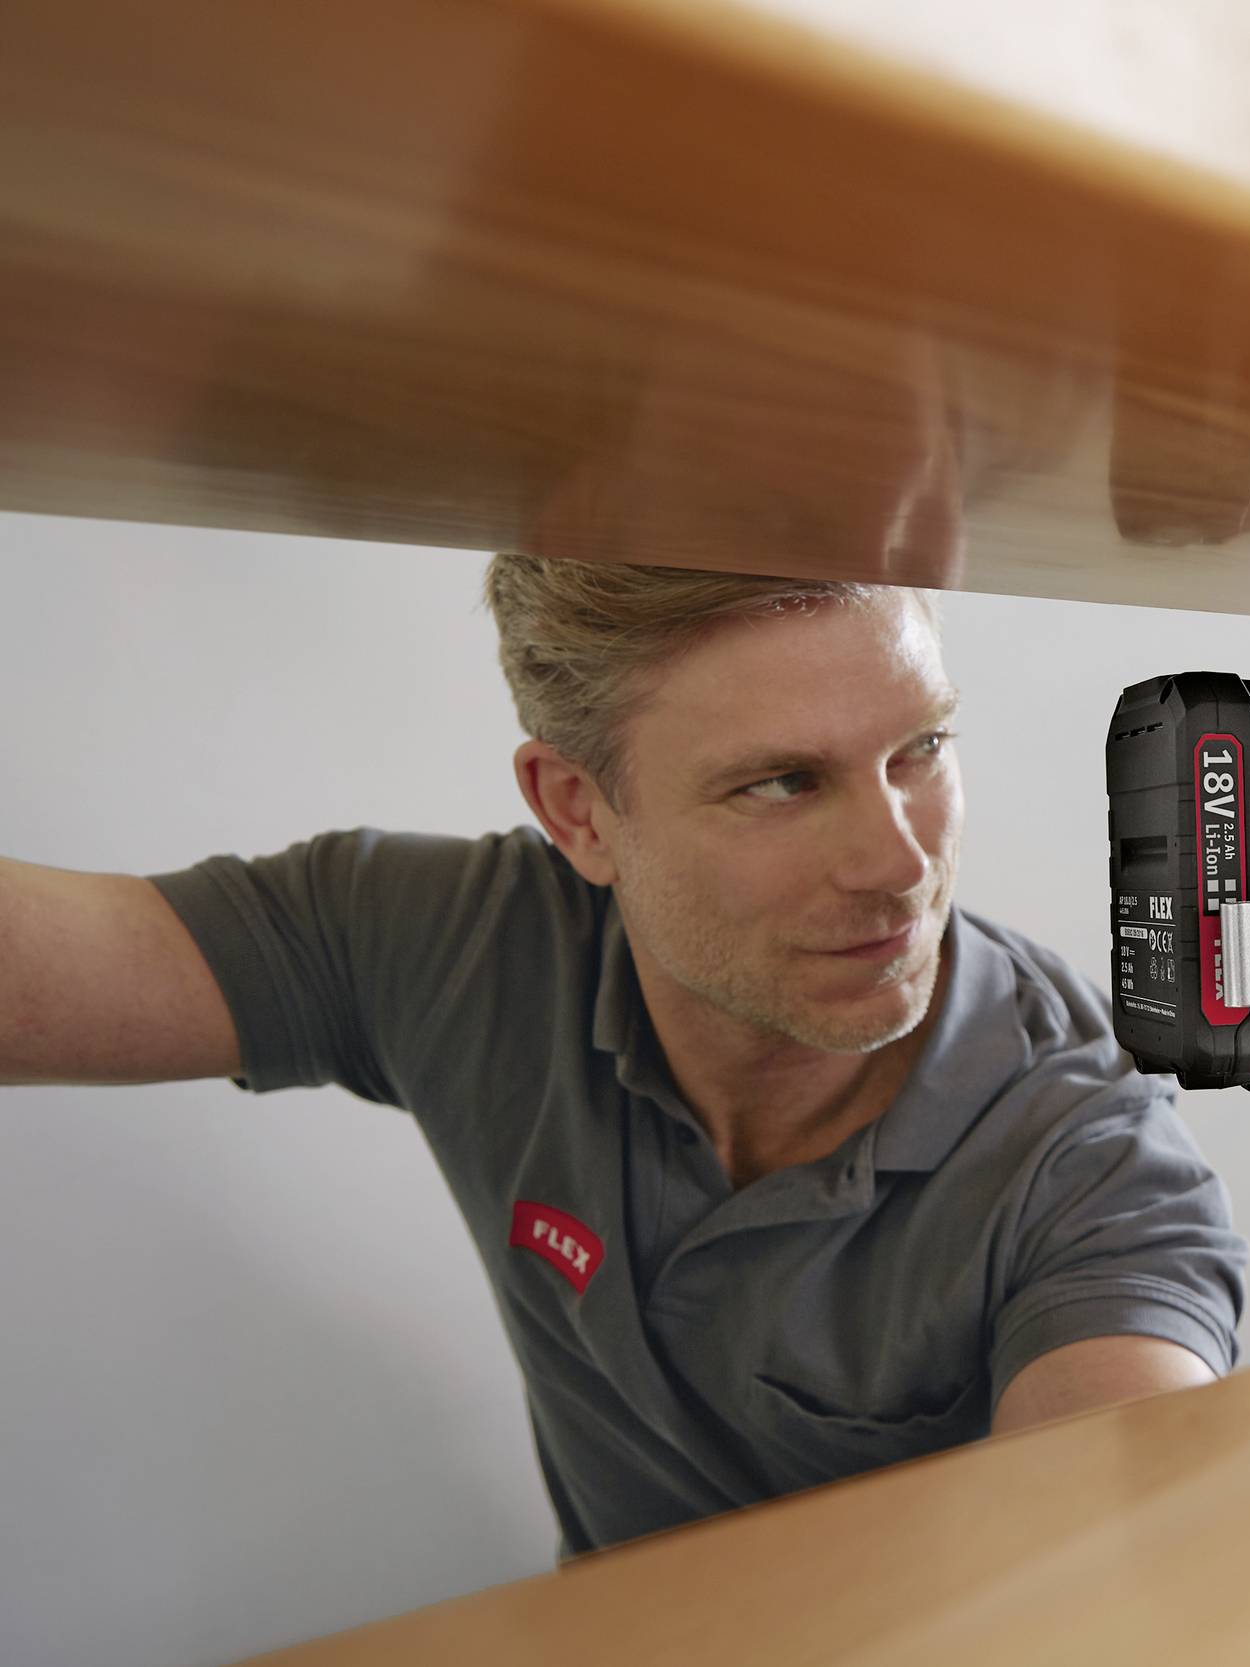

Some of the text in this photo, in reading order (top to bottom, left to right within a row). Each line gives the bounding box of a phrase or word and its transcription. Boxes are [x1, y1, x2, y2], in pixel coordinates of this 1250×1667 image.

[1203, 749, 1235, 819] 18V
[1205, 824, 1221, 875] Li-Ion
[1224, 823, 1236, 860] 2.5 Ah
[1149, 896, 1173, 920] FLEX
[532, 1218, 591, 1275] FLEX
